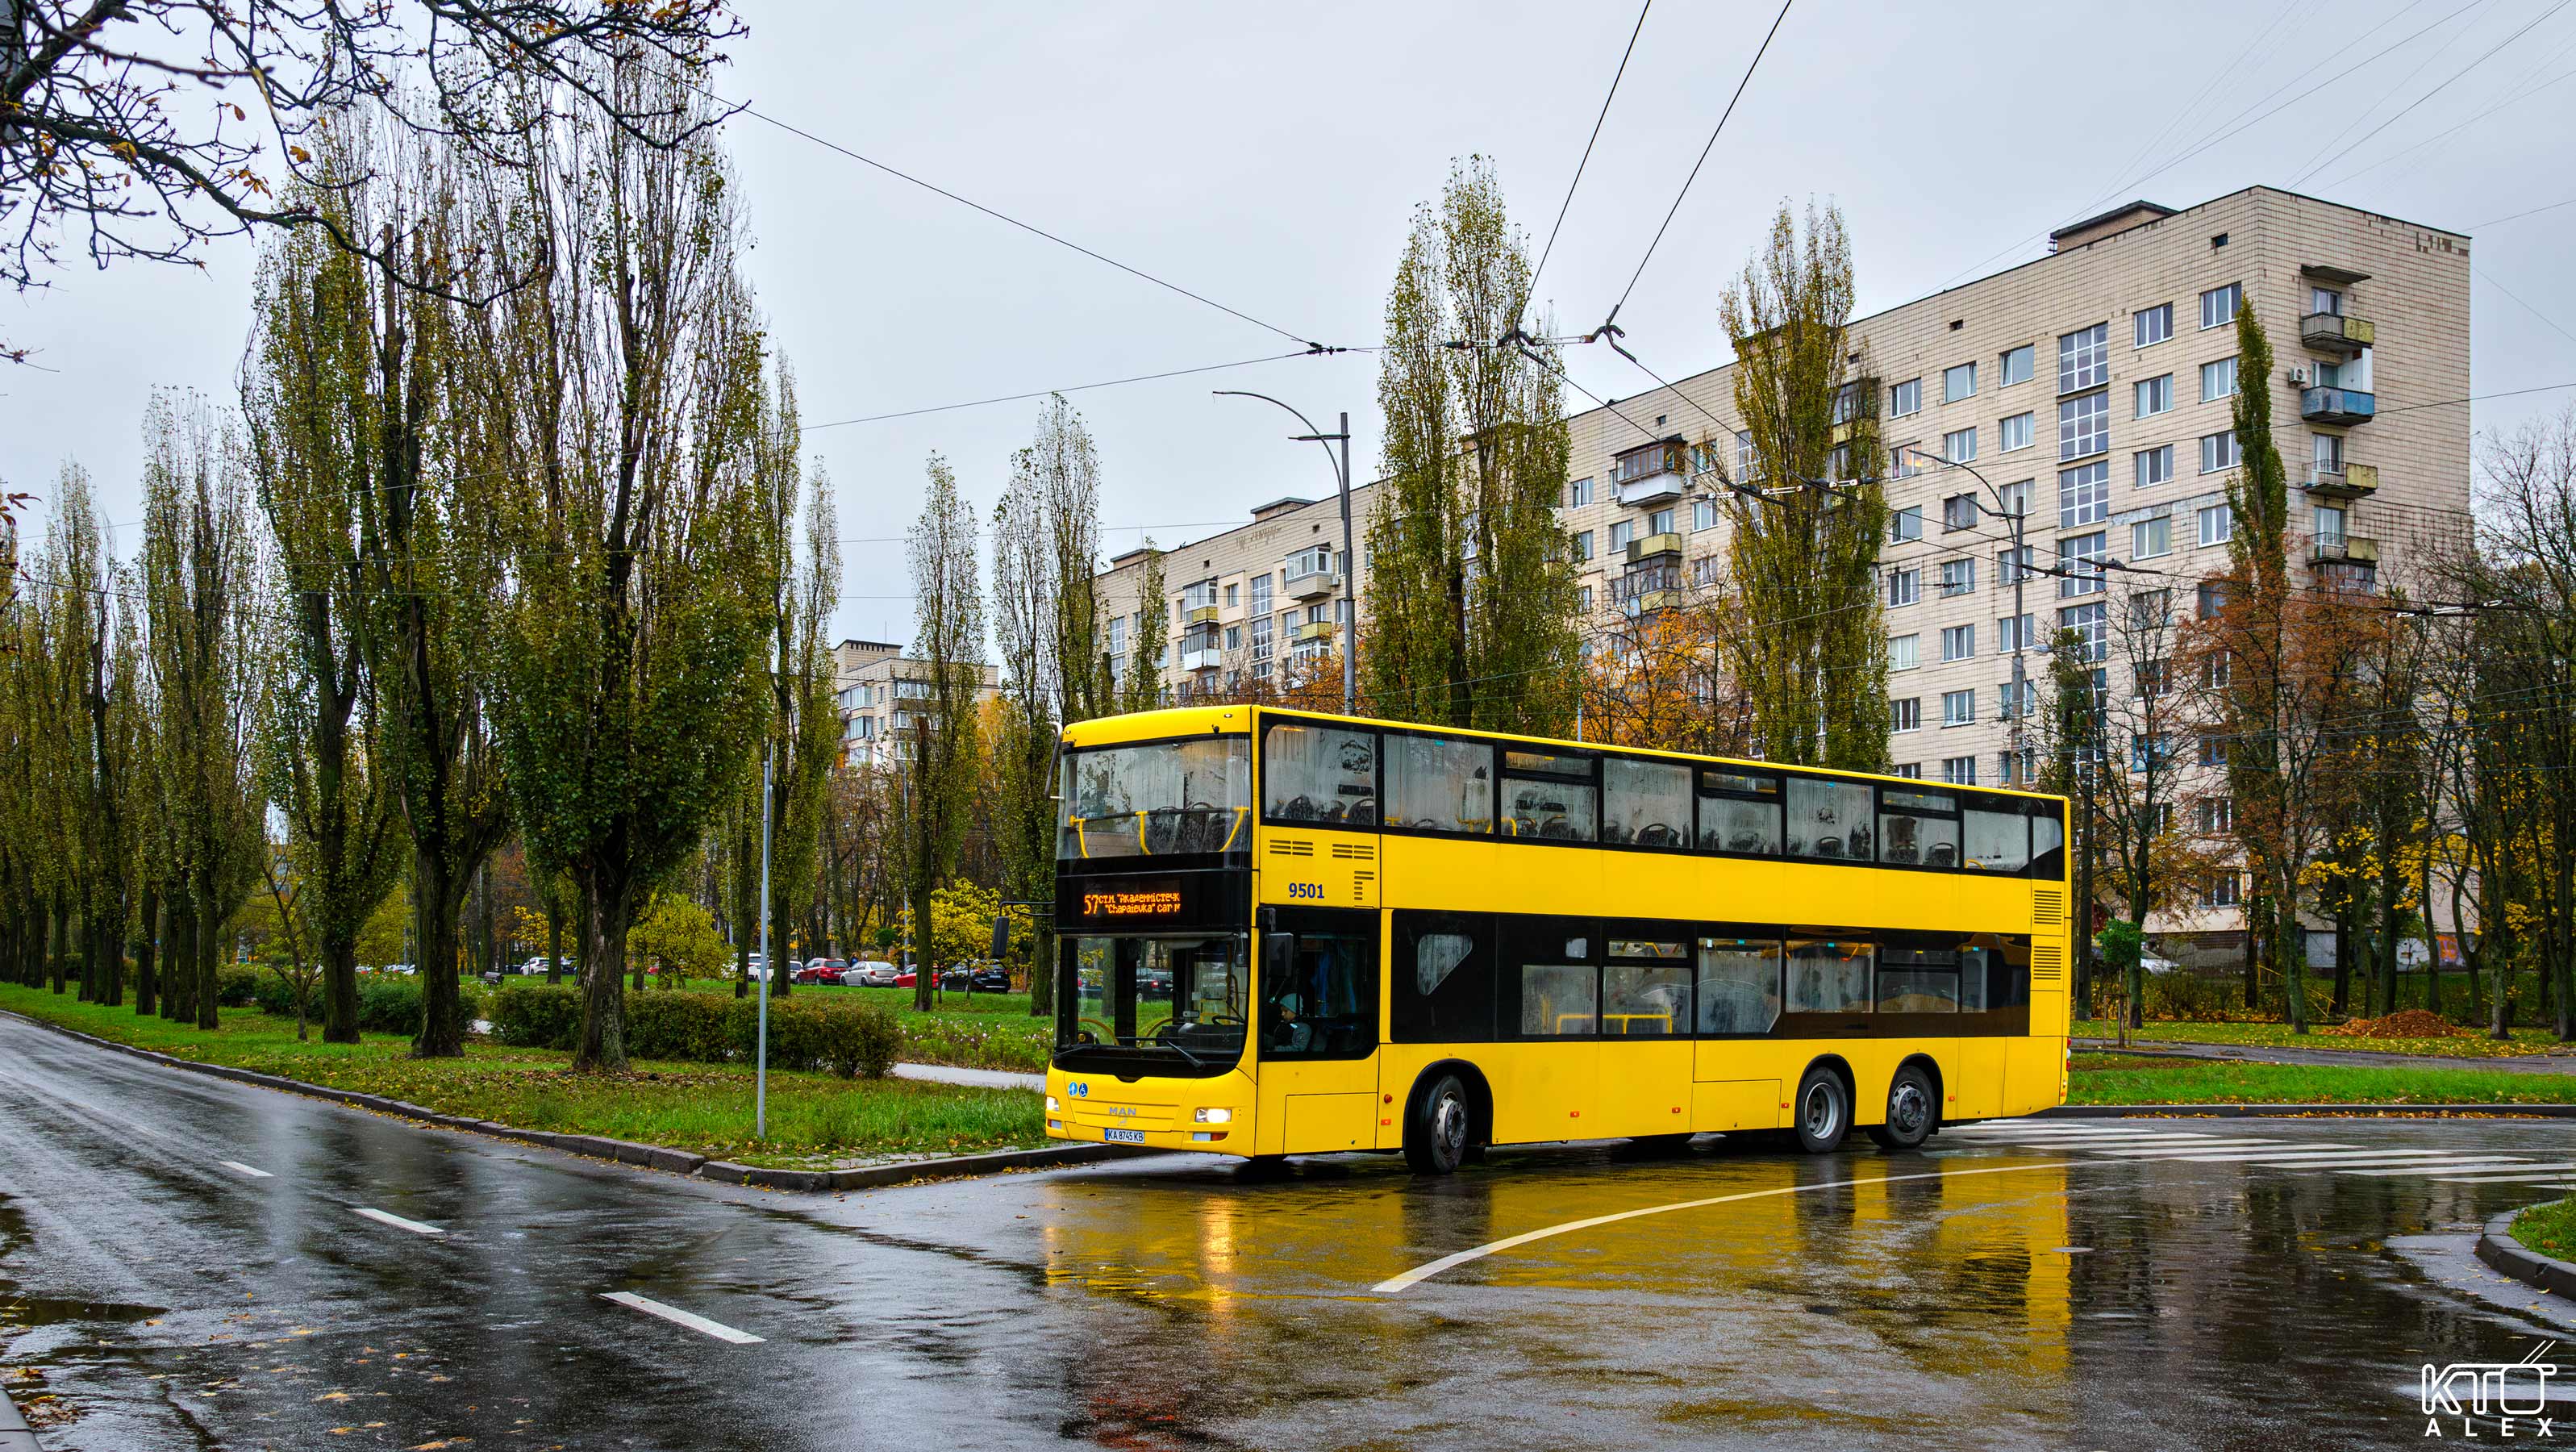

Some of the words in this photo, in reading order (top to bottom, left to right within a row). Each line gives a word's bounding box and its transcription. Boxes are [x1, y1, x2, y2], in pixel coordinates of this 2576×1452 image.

[1289, 882, 1324, 899] 9501
[1083, 894, 1098, 915] 57
[1157, 903, 1173, 913] car
[1109, 1106, 1136, 1116] MAN
[1108, 1129, 1118, 1140] KA
[1119, 1130, 1133, 1141] 8745
[1133, 1132, 1144, 1141] KB
